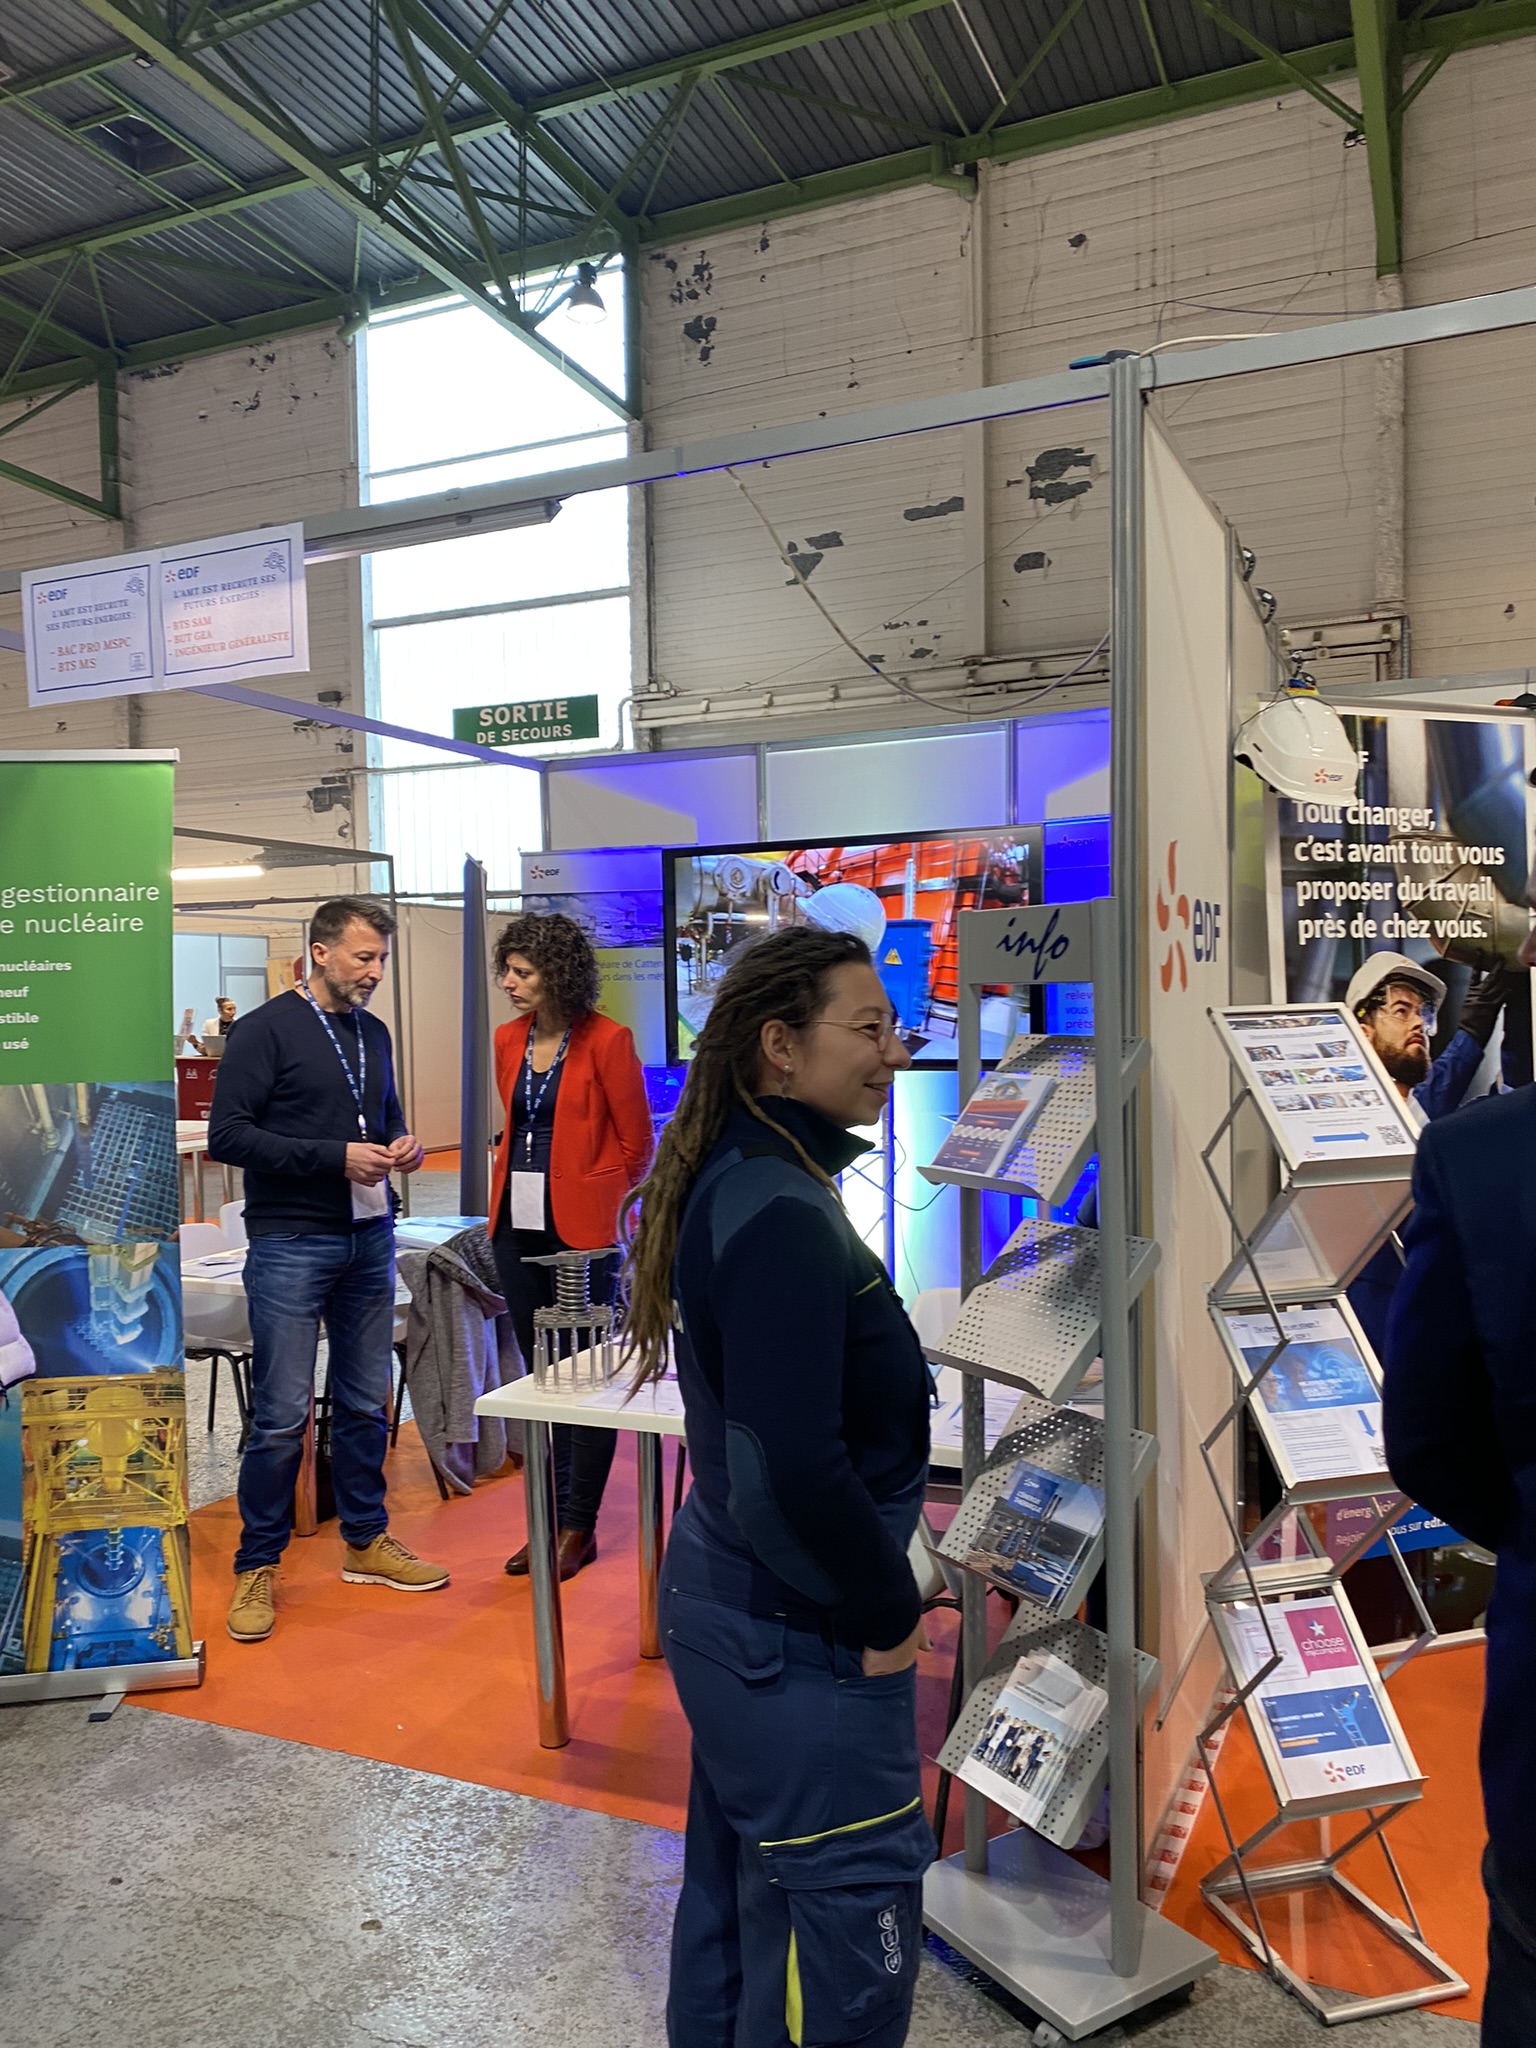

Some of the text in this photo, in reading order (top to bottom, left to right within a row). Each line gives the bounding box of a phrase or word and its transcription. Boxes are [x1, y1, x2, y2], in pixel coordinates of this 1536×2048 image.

[202, 584, 218, 594] EST
[221, 576, 258, 592] RECRUTE
[260, 574, 276, 584] SES
[184, 598, 217, 610] FUTURS
[173, 620, 190, 630] BTS
[192, 616, 212, 627] SAM
[174, 633, 192, 644] BUT
[194, 630, 212, 640] GEA
[57, 644, 77, 656] BAC
[80, 642, 100, 653] PRO
[57, 661, 76, 672] BTS
[479, 700, 569, 726] SORTIE
[476, 724, 572, 744] DE SECOURS
[1292, 799, 1435, 832] Tout changer,
[1294, 835, 1505, 865] c'est avant tout vous
[1, 883, 160, 908] gestionnaire
[1296, 876, 1494, 906] proposer du travail
[26, 912, 144, 933] nucléaire
[1298, 912, 1487, 944] près de chez vous.
[996, 908, 1070, 980] info
[3, 1038, 29, 1049] usé
[1408, 1522, 1421, 1532] sur
[1301, 1637, 1344, 1650] choose
